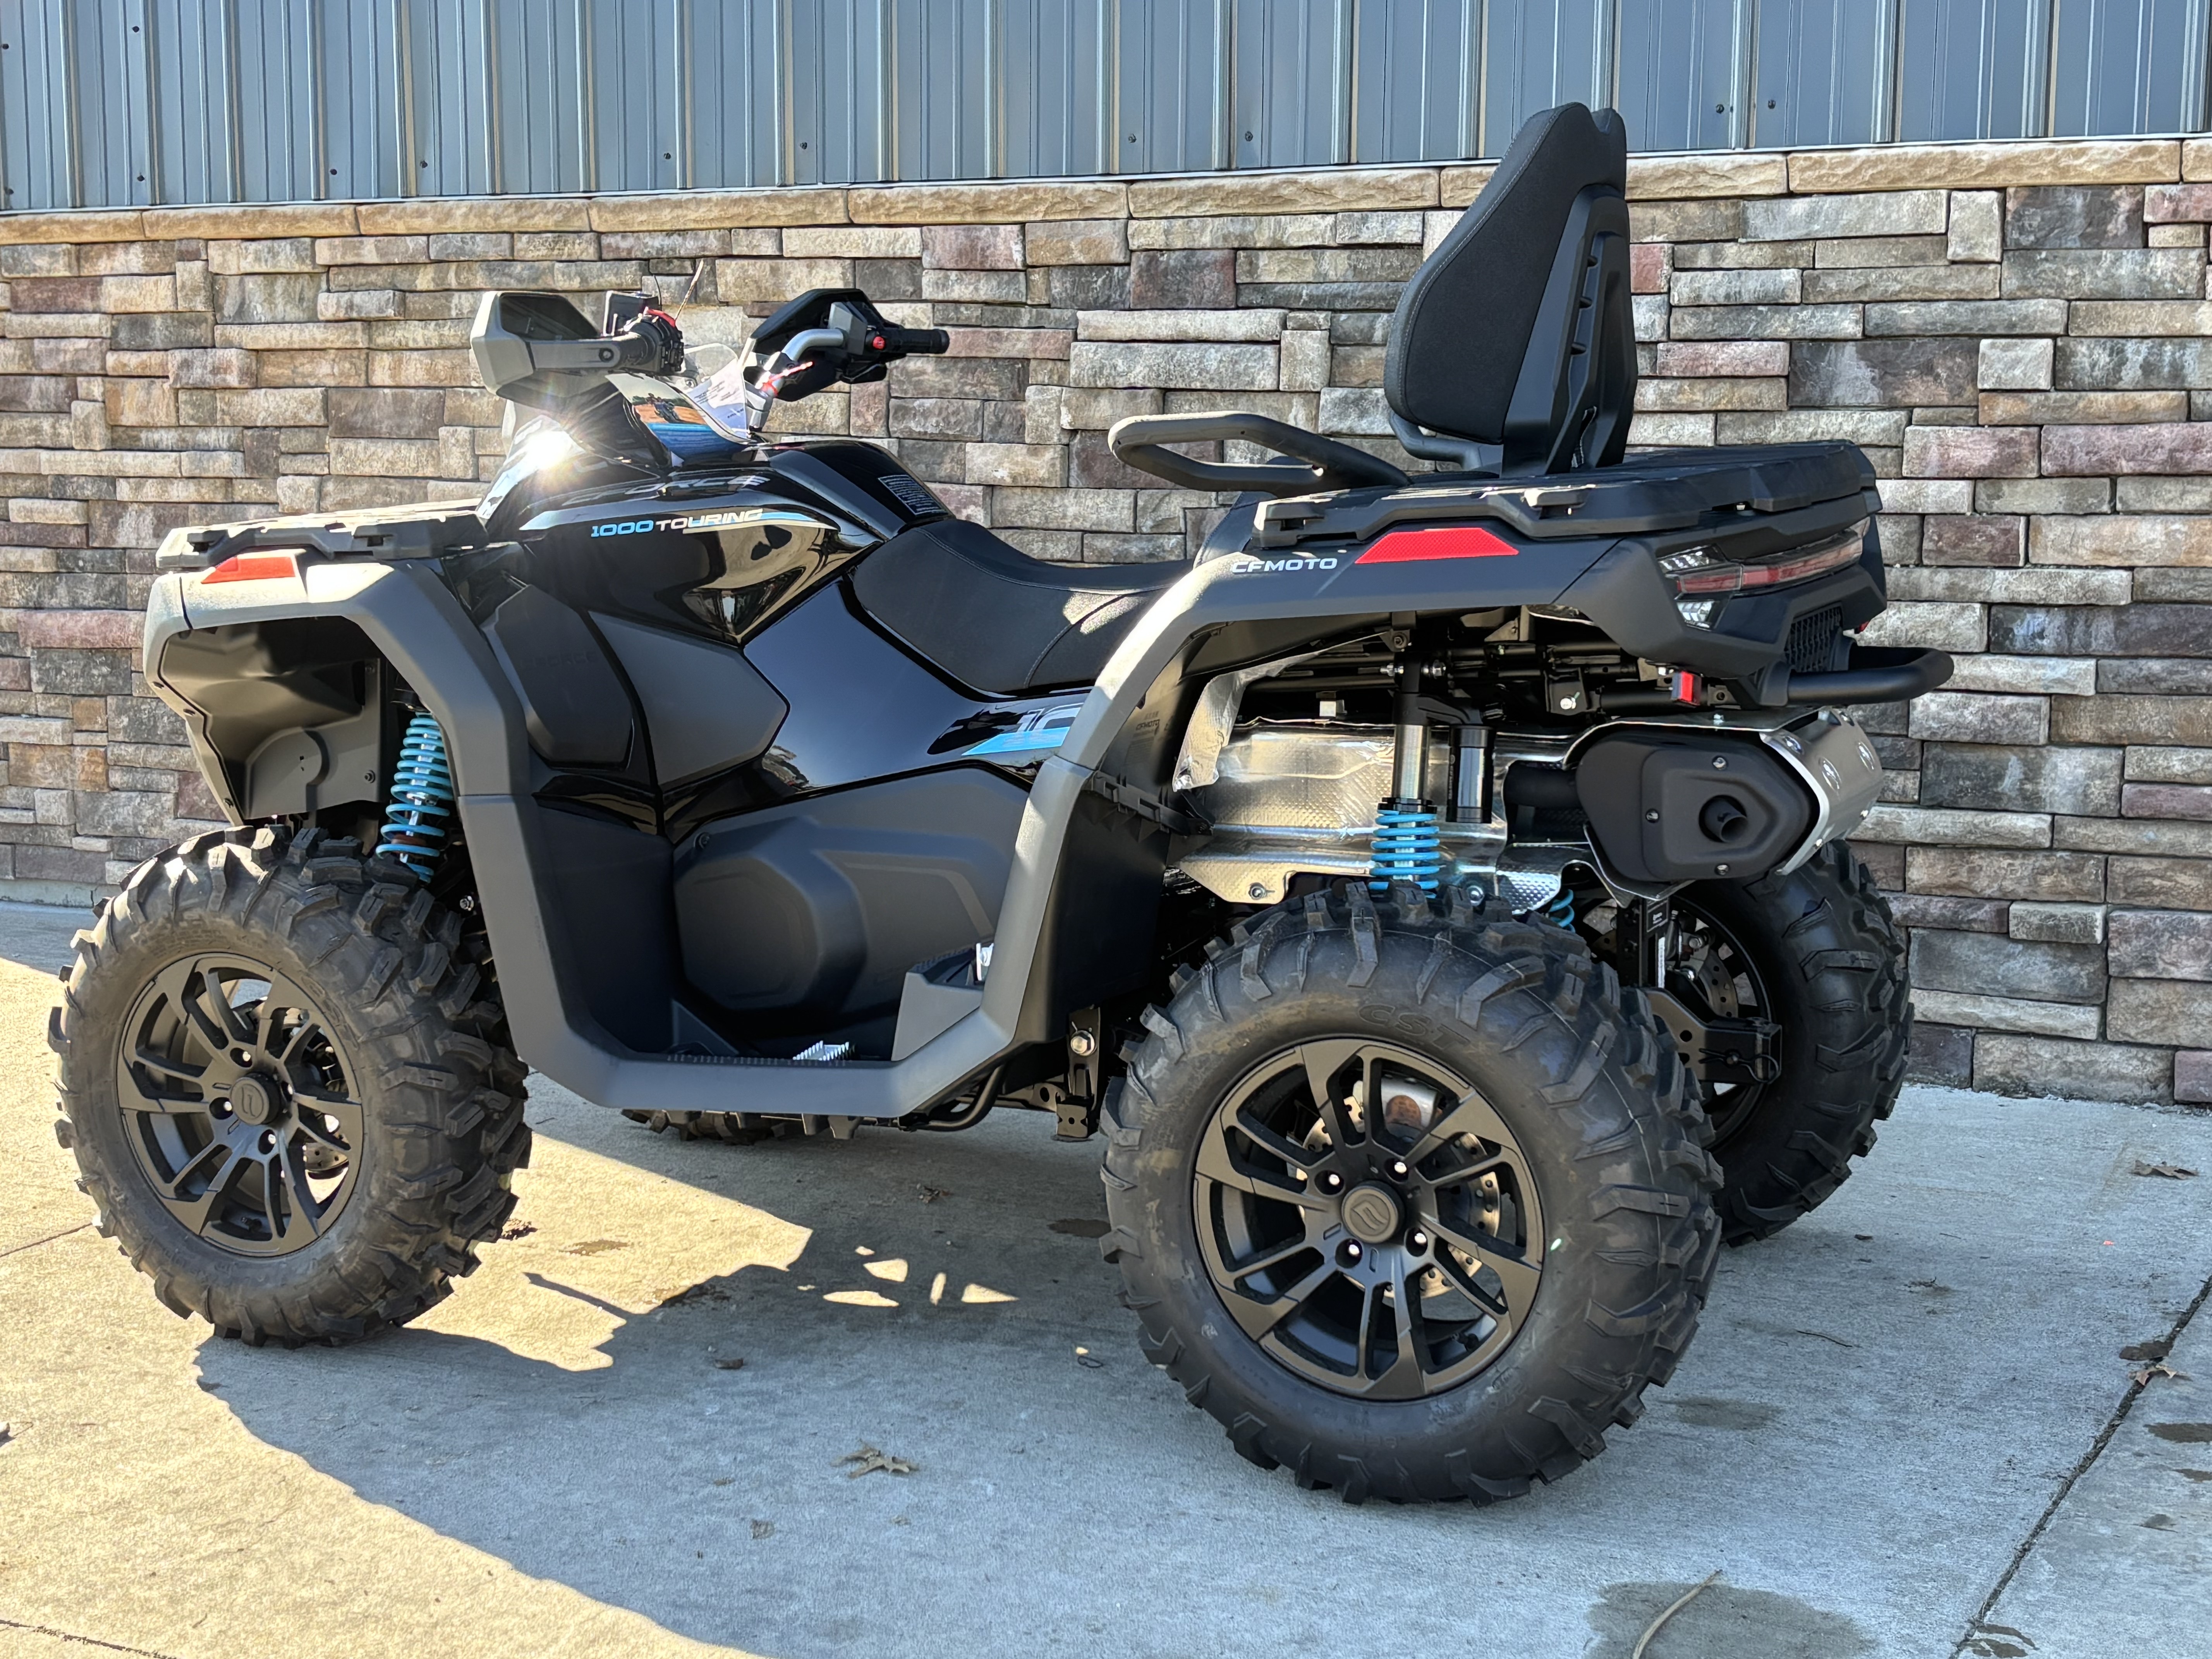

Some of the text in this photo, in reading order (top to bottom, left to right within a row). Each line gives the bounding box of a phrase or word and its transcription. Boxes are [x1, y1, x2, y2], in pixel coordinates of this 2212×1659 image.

[591, 508, 763, 538] 1000 TOURING
[1231, 558, 1338, 573] CFMOTO
[1357, 1003, 1471, 1051] CST
